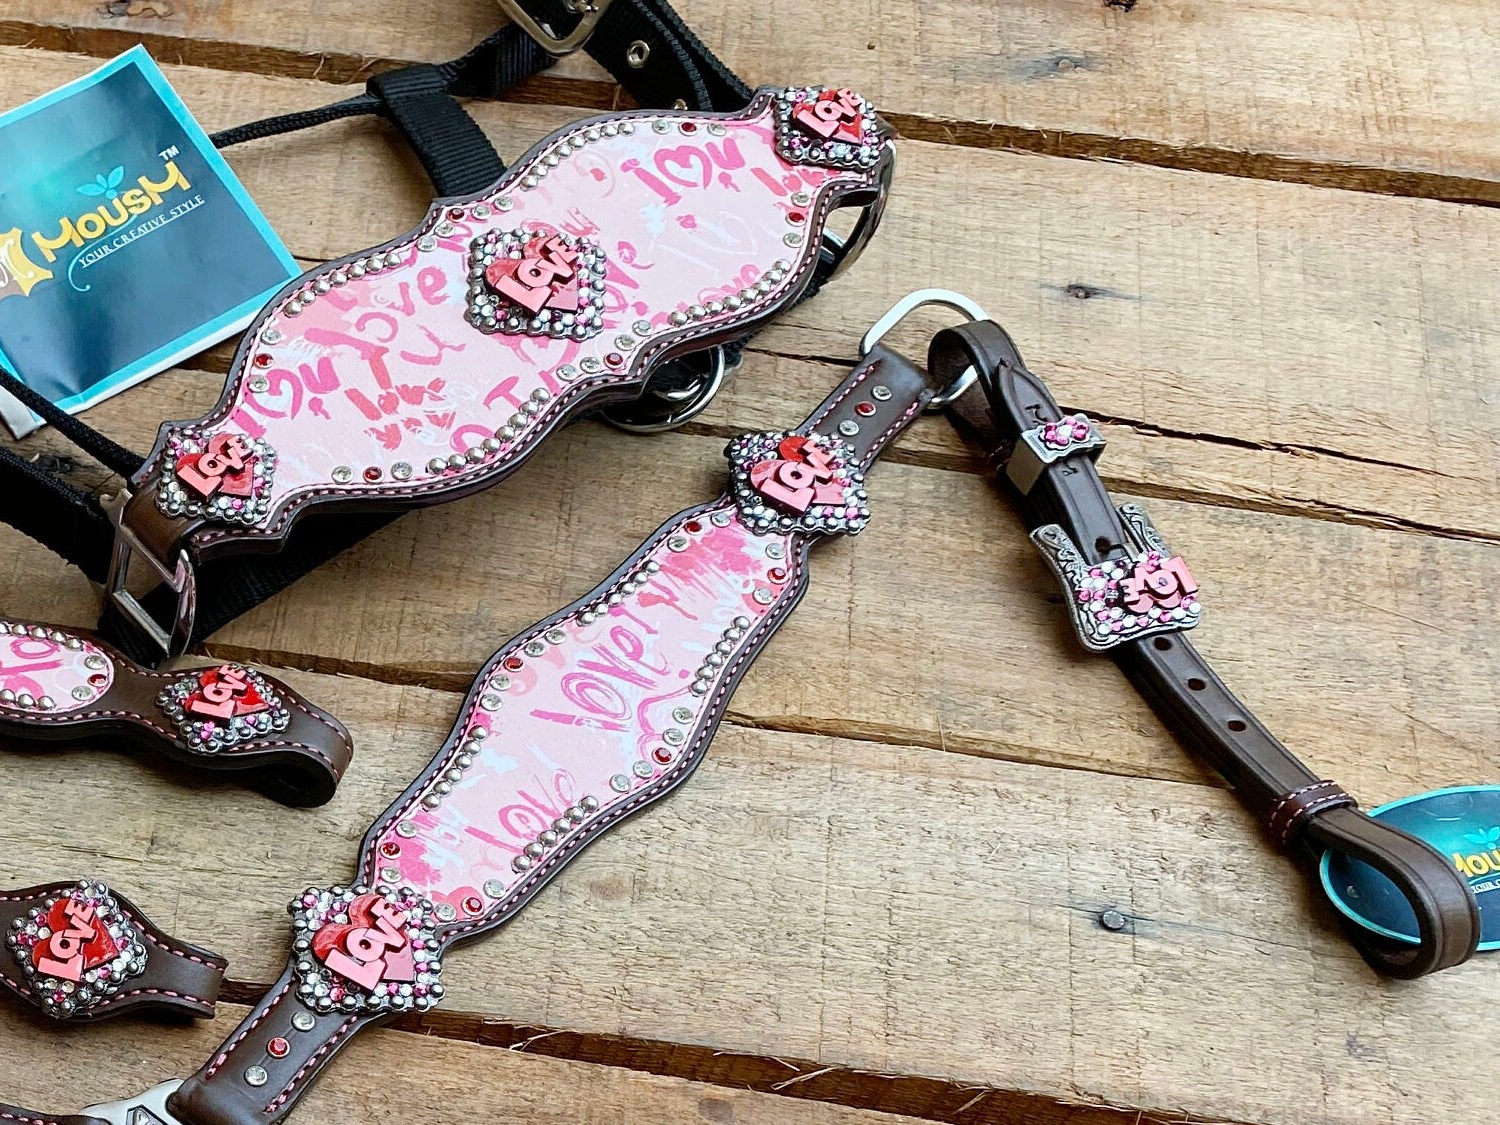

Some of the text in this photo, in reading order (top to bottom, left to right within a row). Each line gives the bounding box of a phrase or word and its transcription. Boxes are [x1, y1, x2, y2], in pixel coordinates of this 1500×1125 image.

[797, 88, 862, 139] LOVE
[79, 194, 206, 268] YOUR CREATIVE STYLE
[498, 235, 579, 313] LOVE
[176, 435, 256, 498] LOVE
[759, 439, 834, 512] LOVE
[1119, 553, 1198, 603] LOVE
[192, 664, 248, 720] LOVE
[37, 897, 96, 982] LOVE
[324, 897, 409, 991] LOVE
